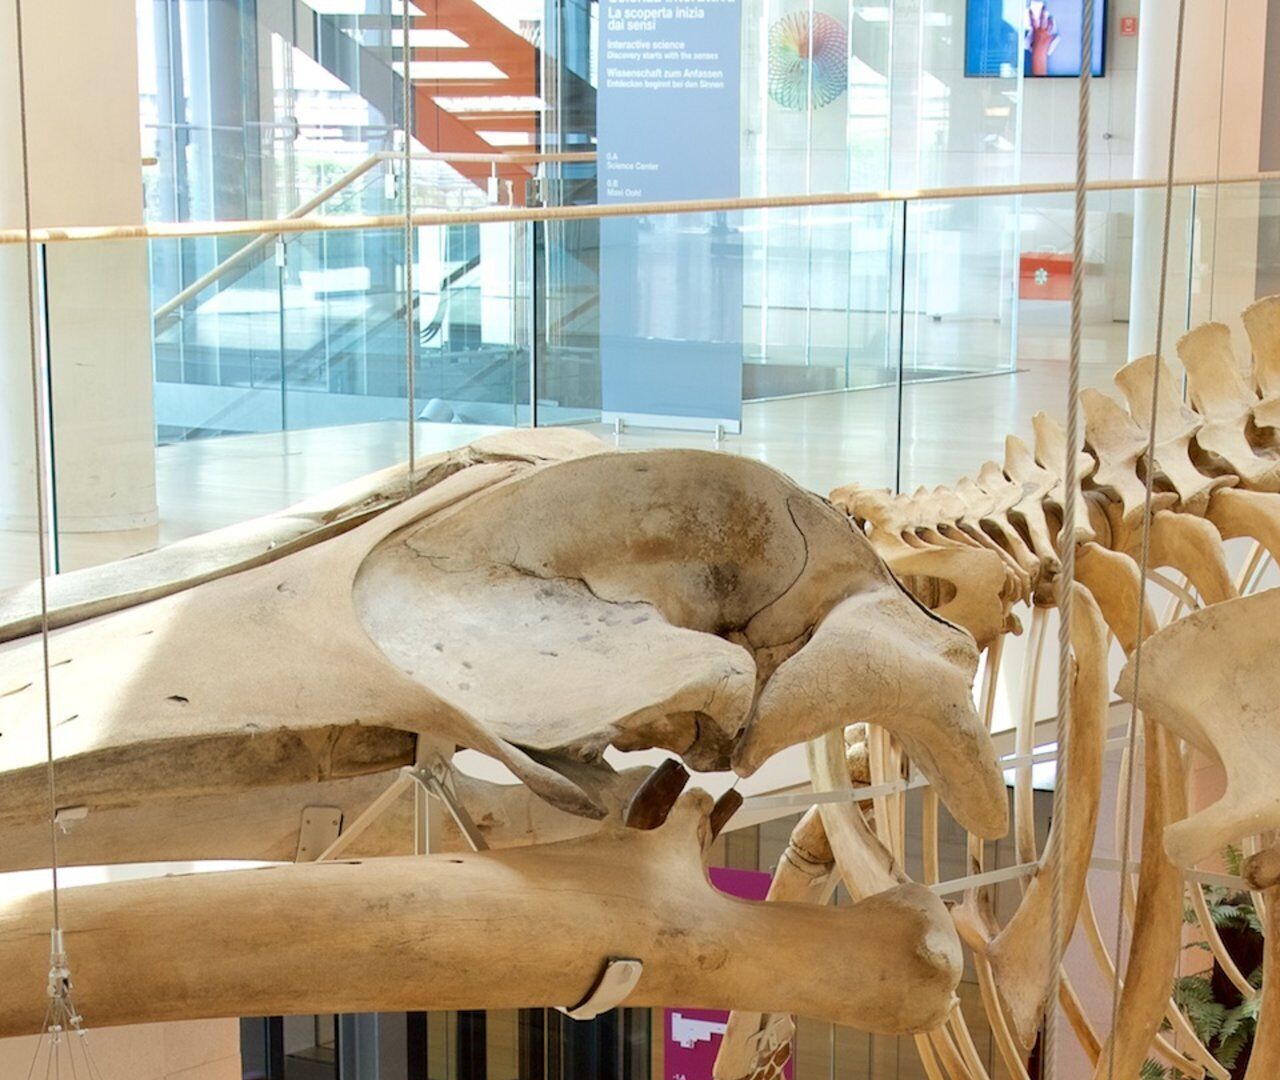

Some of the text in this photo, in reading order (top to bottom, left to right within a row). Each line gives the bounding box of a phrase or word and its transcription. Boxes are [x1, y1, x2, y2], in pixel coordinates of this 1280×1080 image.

[608, 6, 705, 21] La scoperta inizia
[607, 18, 657, 31] dai sensi
[607, 39, 685, 49] Interactive science
[607, 51, 641, 61] Discovery
[643, 51, 663, 60] starts
[664, 51, 679, 60] with
[680, 51, 692, 60] the
[606, 68, 723, 78] Wissenschaft zum Anfassen
